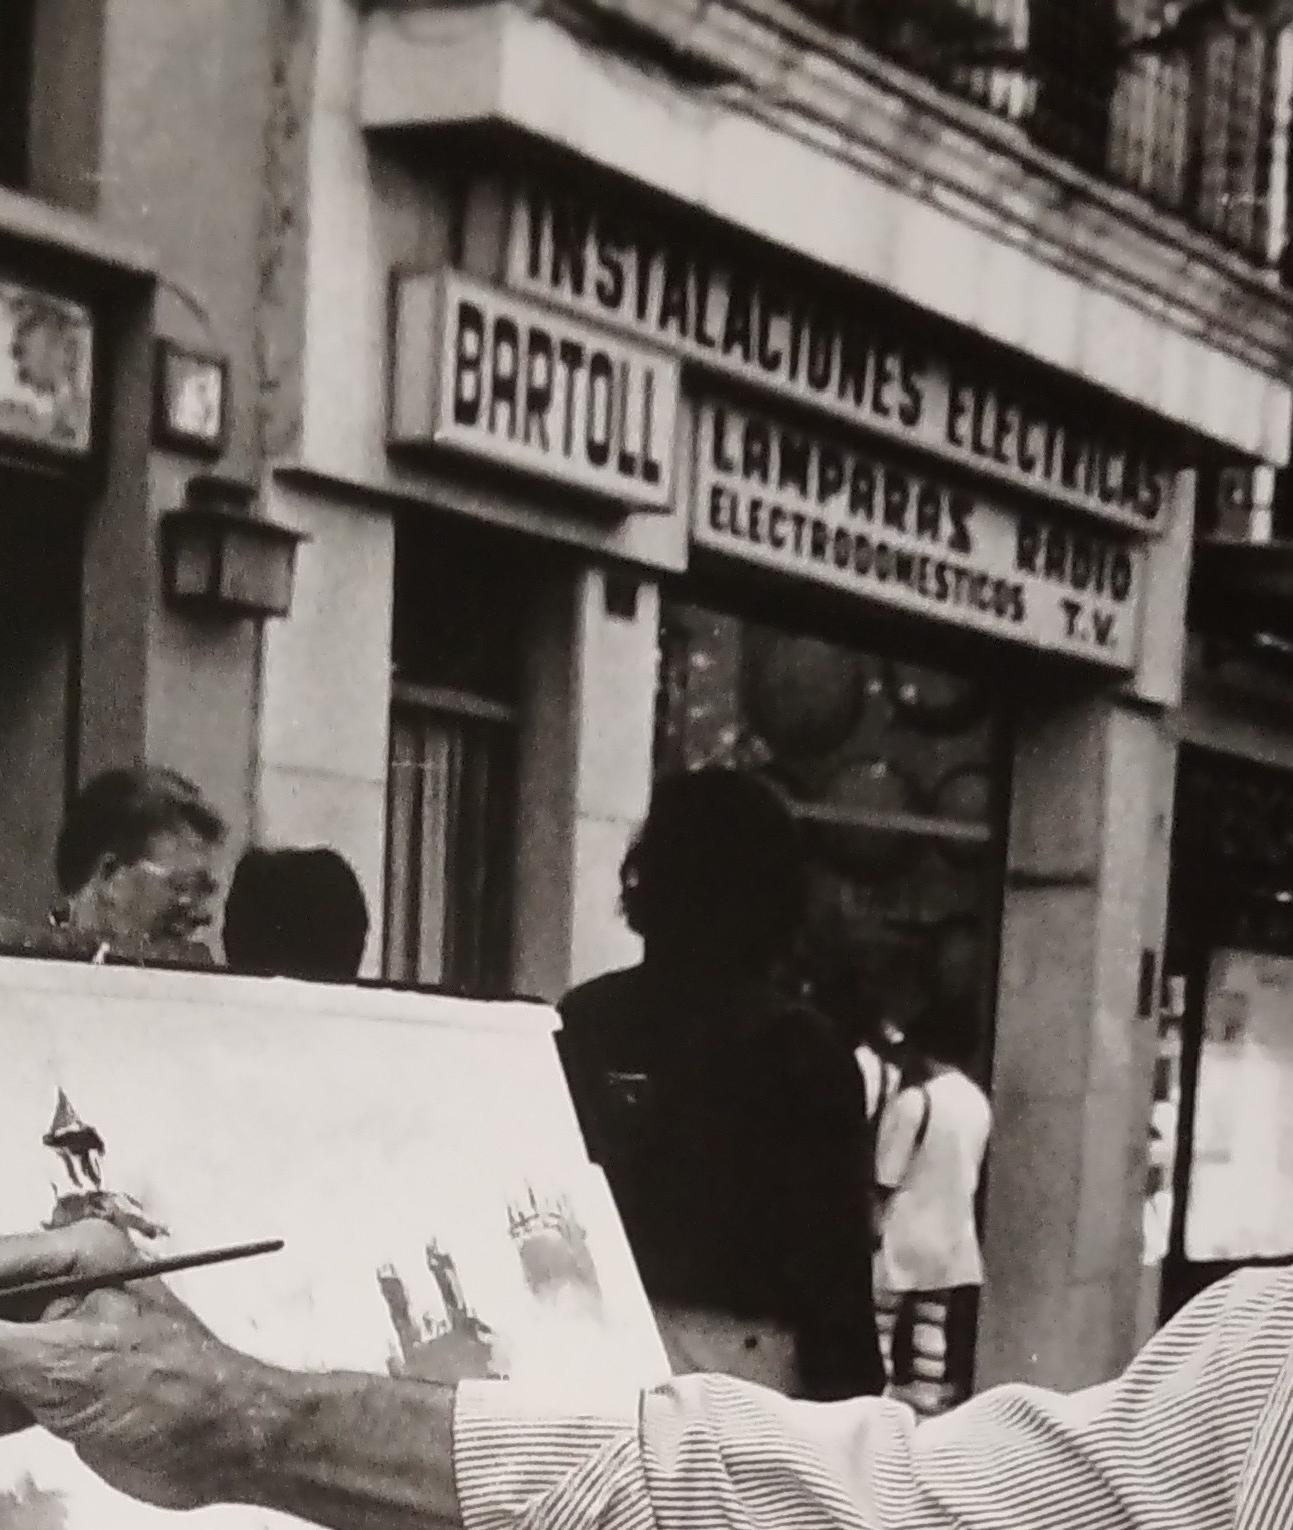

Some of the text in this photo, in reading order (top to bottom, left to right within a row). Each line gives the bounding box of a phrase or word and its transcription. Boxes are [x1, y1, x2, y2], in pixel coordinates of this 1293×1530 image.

[454, 300, 660, 480] BARTOLL
[527, 203, 924, 427] INSTALACIONES
[708, 484, 1025, 624] ELECTRODOMESTICOS
[712, 405, 1133, 603] LAMPARAS RADIO
